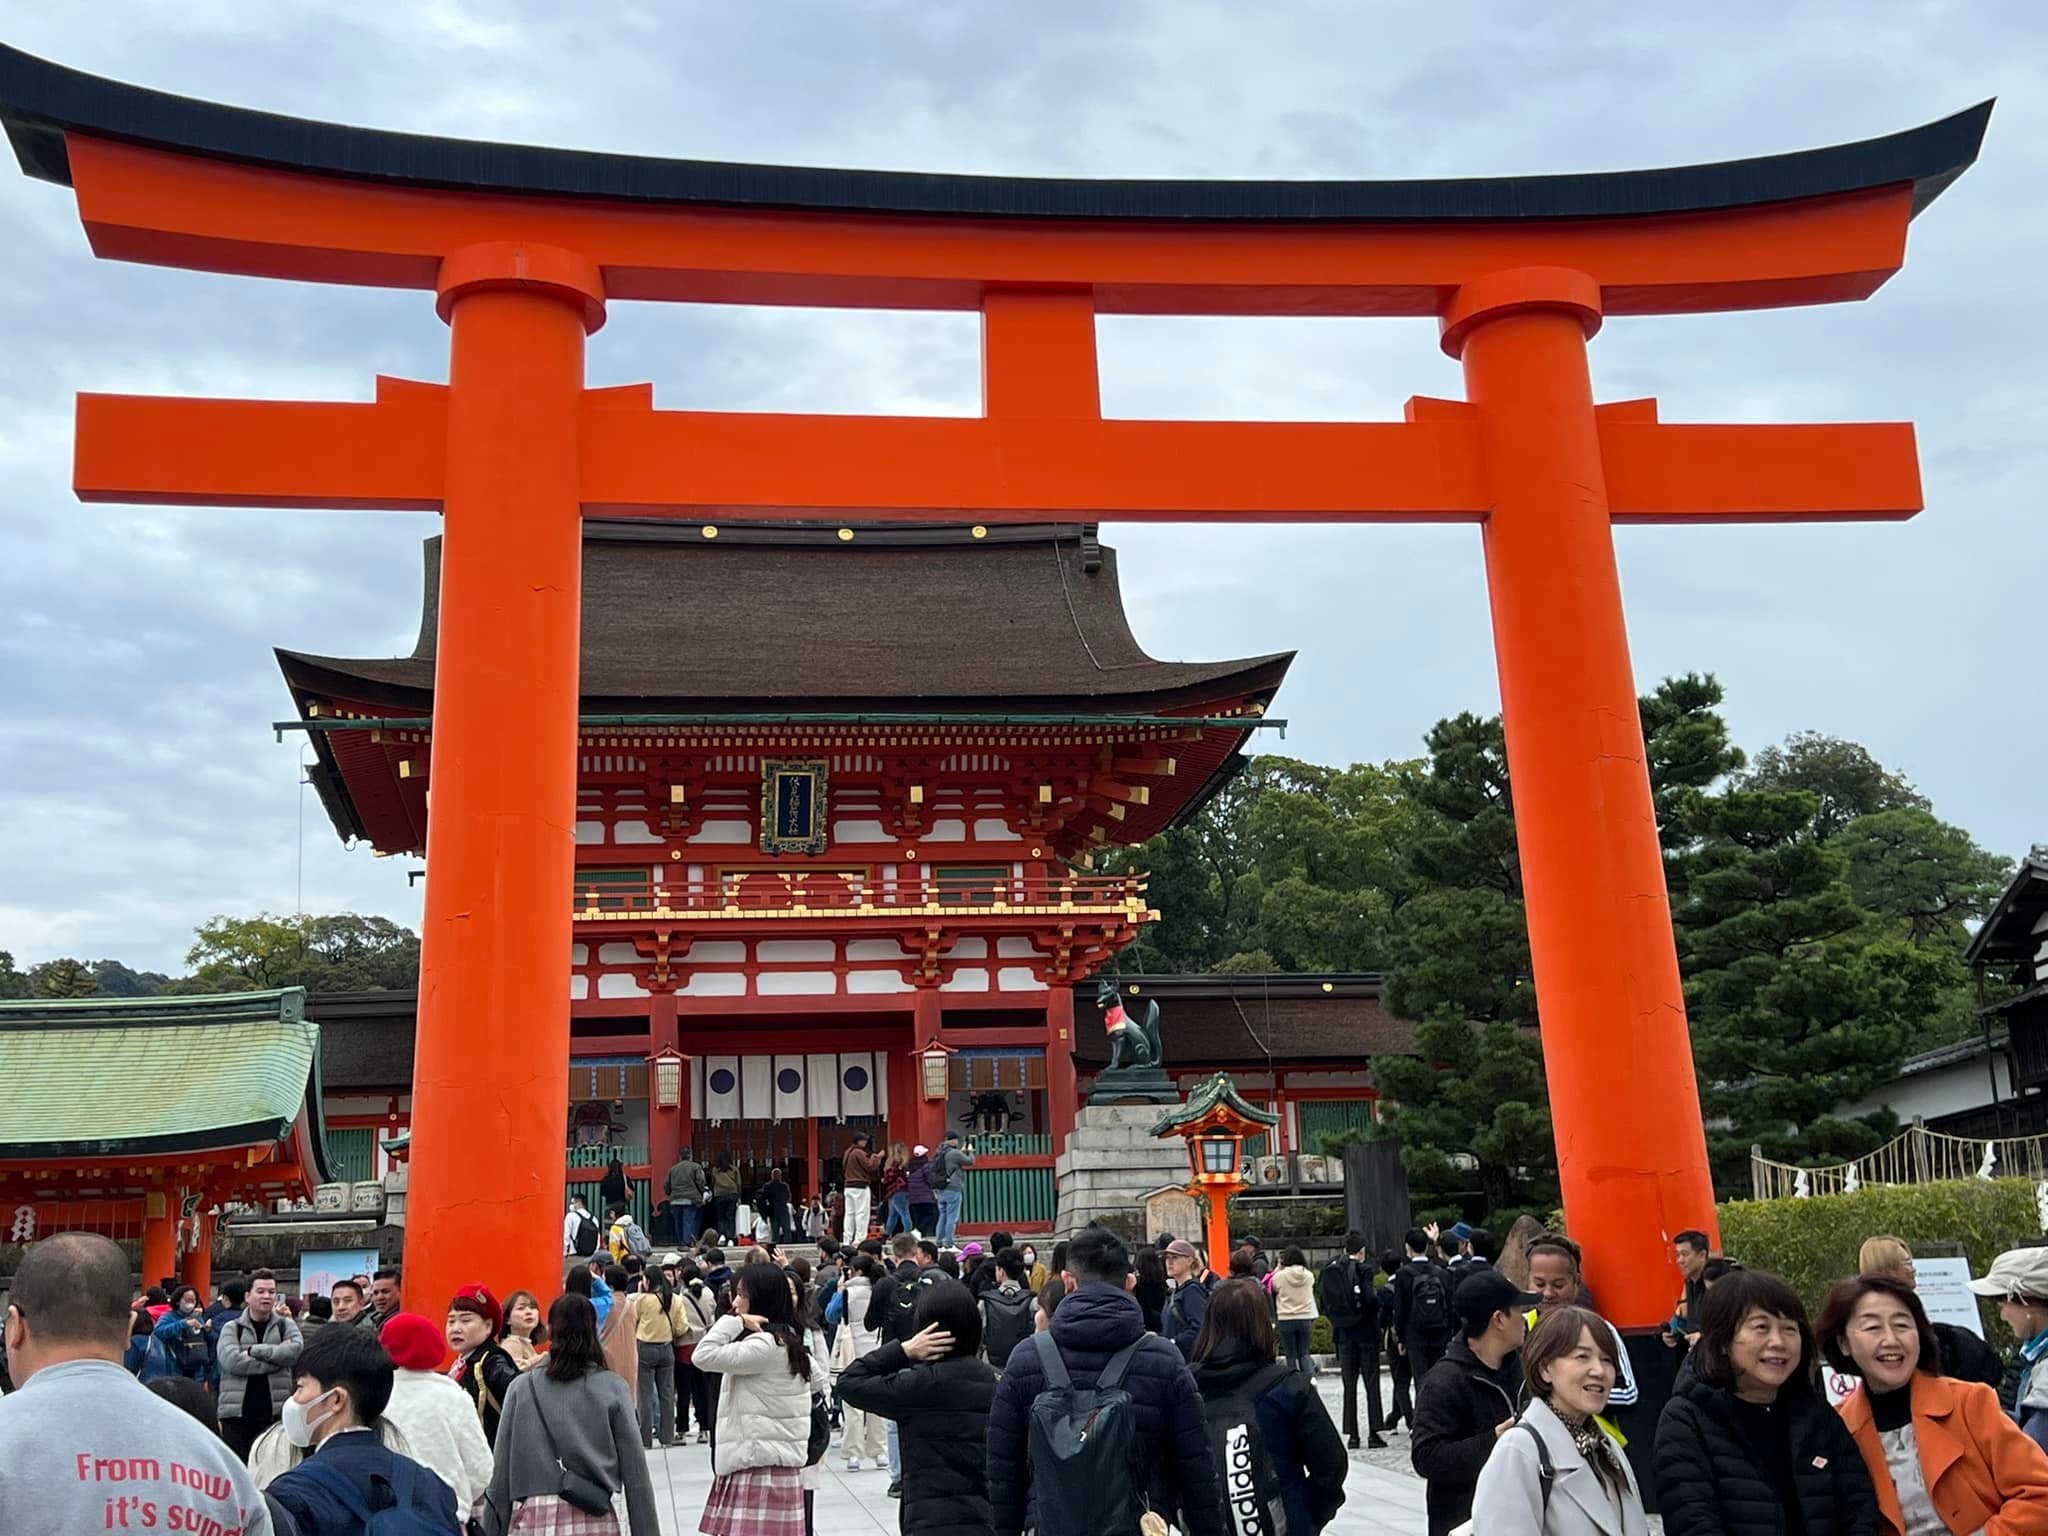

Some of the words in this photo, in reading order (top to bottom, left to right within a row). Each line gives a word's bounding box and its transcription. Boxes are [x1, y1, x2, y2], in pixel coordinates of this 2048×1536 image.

[76, 1453, 160, 1482] From
[170, 1462, 231, 1501] now
[1229, 1434, 1263, 1536] adidas
[105, 1496, 158, 1529] it's
